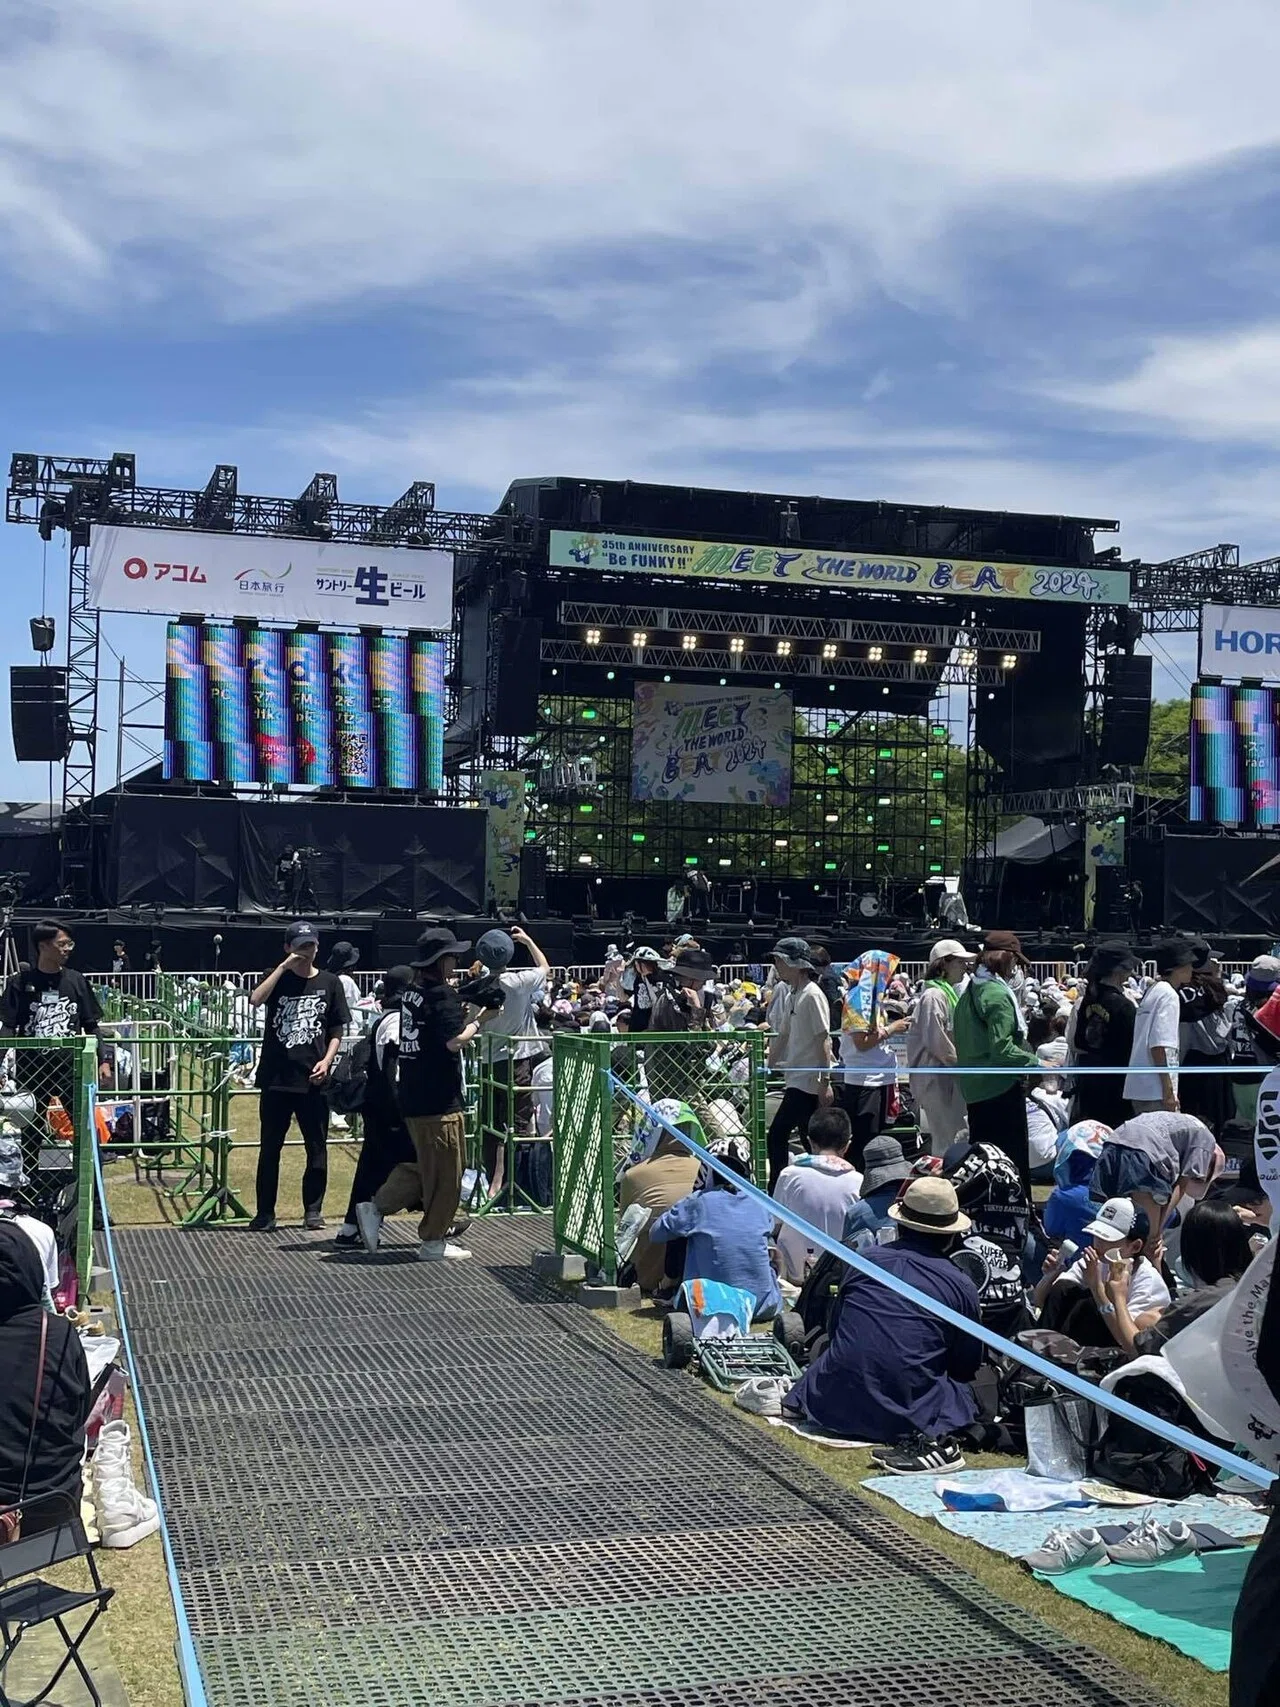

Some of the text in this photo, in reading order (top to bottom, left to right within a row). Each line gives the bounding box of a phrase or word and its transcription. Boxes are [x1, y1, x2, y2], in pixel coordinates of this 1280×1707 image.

[601, 540, 695, 555] 35th ANNIVERSARY
[153, 563, 207, 584] アコム
[691, 545, 1100, 600] MEET THE WORLD BEAT 2024
[239, 580, 285, 593] 日本旅行
[672, 701, 751, 740] MEET
[683, 728, 745, 752] THE WORLD
[662, 735, 767, 784] BEAT 2024
[980, 1244, 1004, 1259] SUPER
[1242, 1301, 1256, 1325] the
